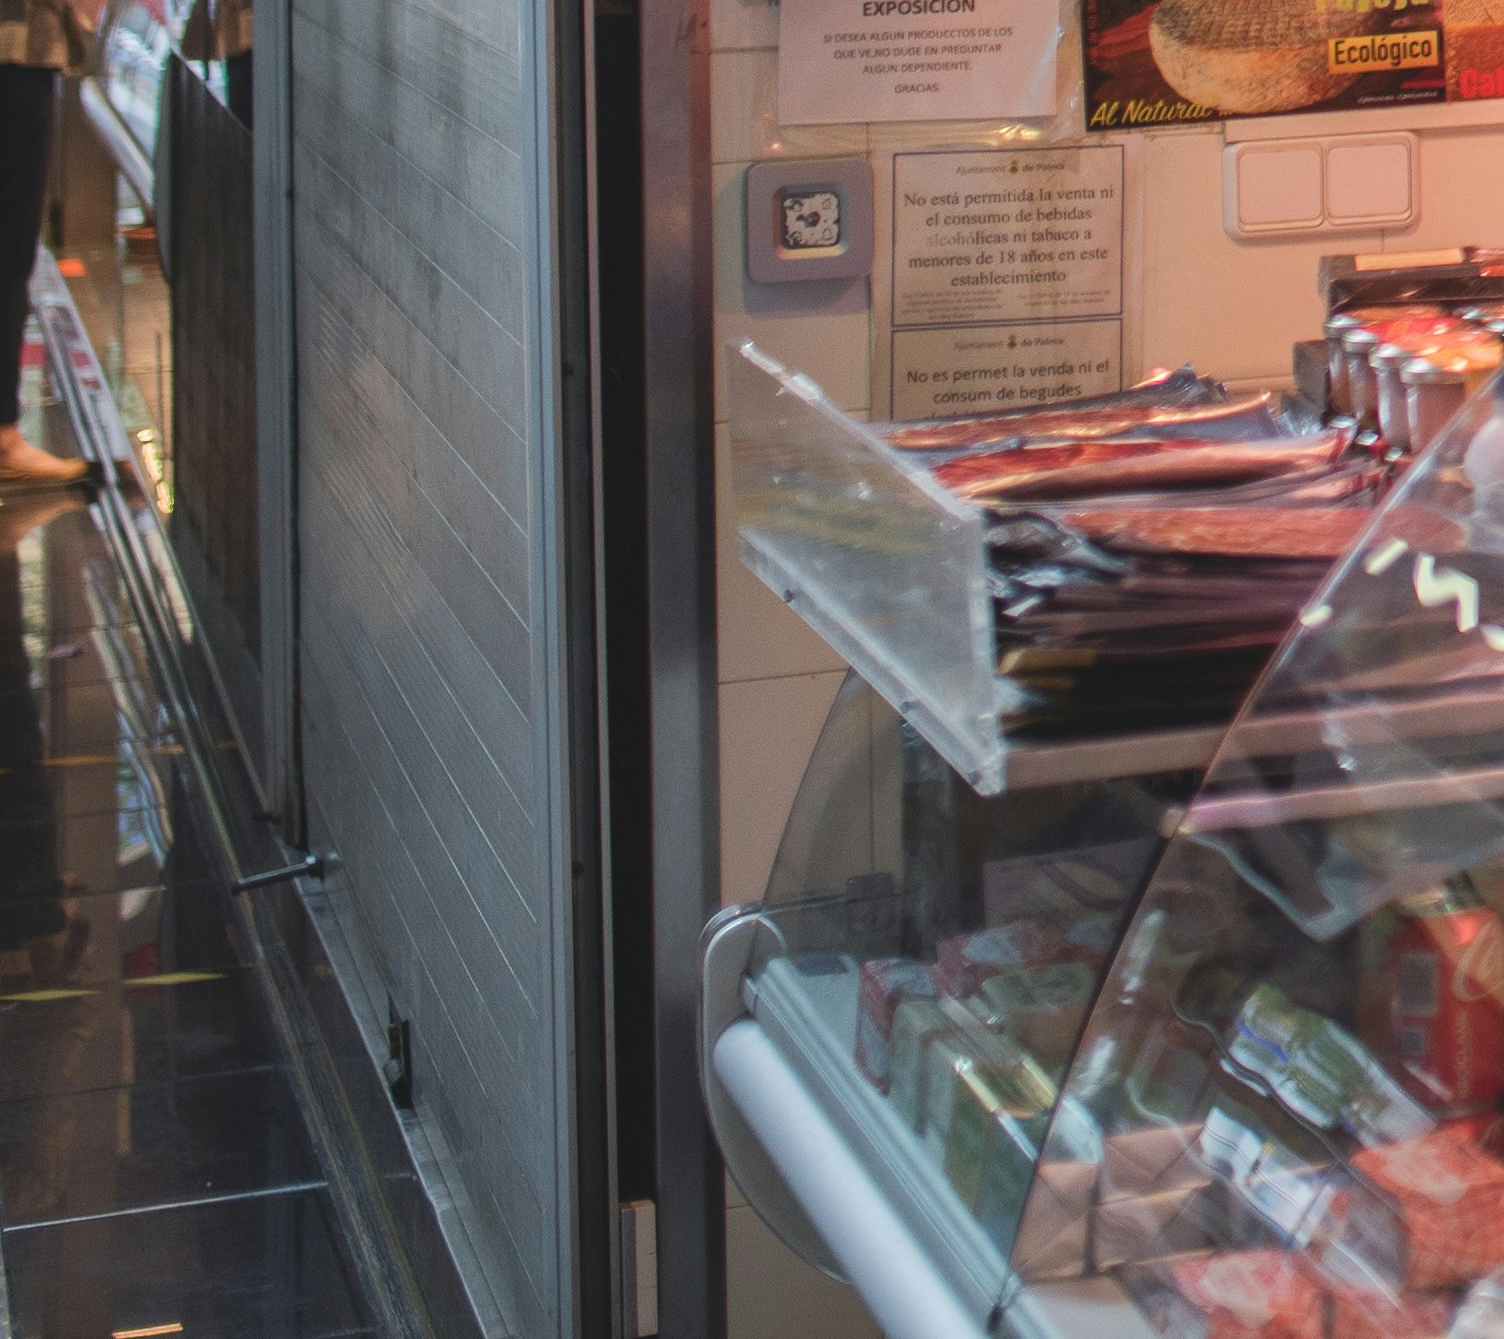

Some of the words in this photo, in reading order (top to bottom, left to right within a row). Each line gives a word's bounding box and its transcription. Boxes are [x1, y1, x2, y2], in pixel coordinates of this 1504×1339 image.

[835, 33, 867, 43] DESEA
[869, 32, 904, 42] ALGUN
[978, 28, 992, 37] DE
[993, 27, 1013, 37] LOS
[834, 49, 856, 60] QUE
[893, 47, 921, 57] DUDE
[924, 46, 939, 56] EN
[941, 44, 1002, 55] PREGUNTAR
[1334, 37, 1432, 68] Ecológico
[862, 64, 898, 74] ALGUN
[1090, 102, 1116, 127] Al
[904, 194, 926, 207] No
[931, 192, 959, 206] está
[964, 190, 1034, 208] permitida
[1039, 189, 1052, 201] la
[1057, 189, 1095, 200] venta
[1100, 185, 1114, 199] ni
[926, 213, 939, 226] el
[944, 213, 1010, 225] consumo
[1015, 210, 1033, 223] de
[1036, 208, 1092, 222] bebidas
[1013, 231, 1027, 243] ni
[1031, 229, 1079, 243] tabaco
[1084, 231, 1092, 240] a
[908, 255, 971, 269] menores
[975, 252, 993, 265] de
[999, 250, 1016, 264] 18
[1020, 248, 1054, 263] años
[1058, 250, 1075, 261] en
[1080, 248, 1109, 260] este
[951, 268, 1066, 287] establecimiento
[907, 370, 928, 384] No
[953, 369, 1008, 385] permet
[1013, 364, 1025, 377] la
[1030, 362, 1073, 376] venda
[1078, 360, 1092, 373] ni
[1096, 359, 1109, 372] el
[933, 389, 991, 404] consum
[996, 386, 1015, 401] de
[1020, 382, 1082, 401] begudes
